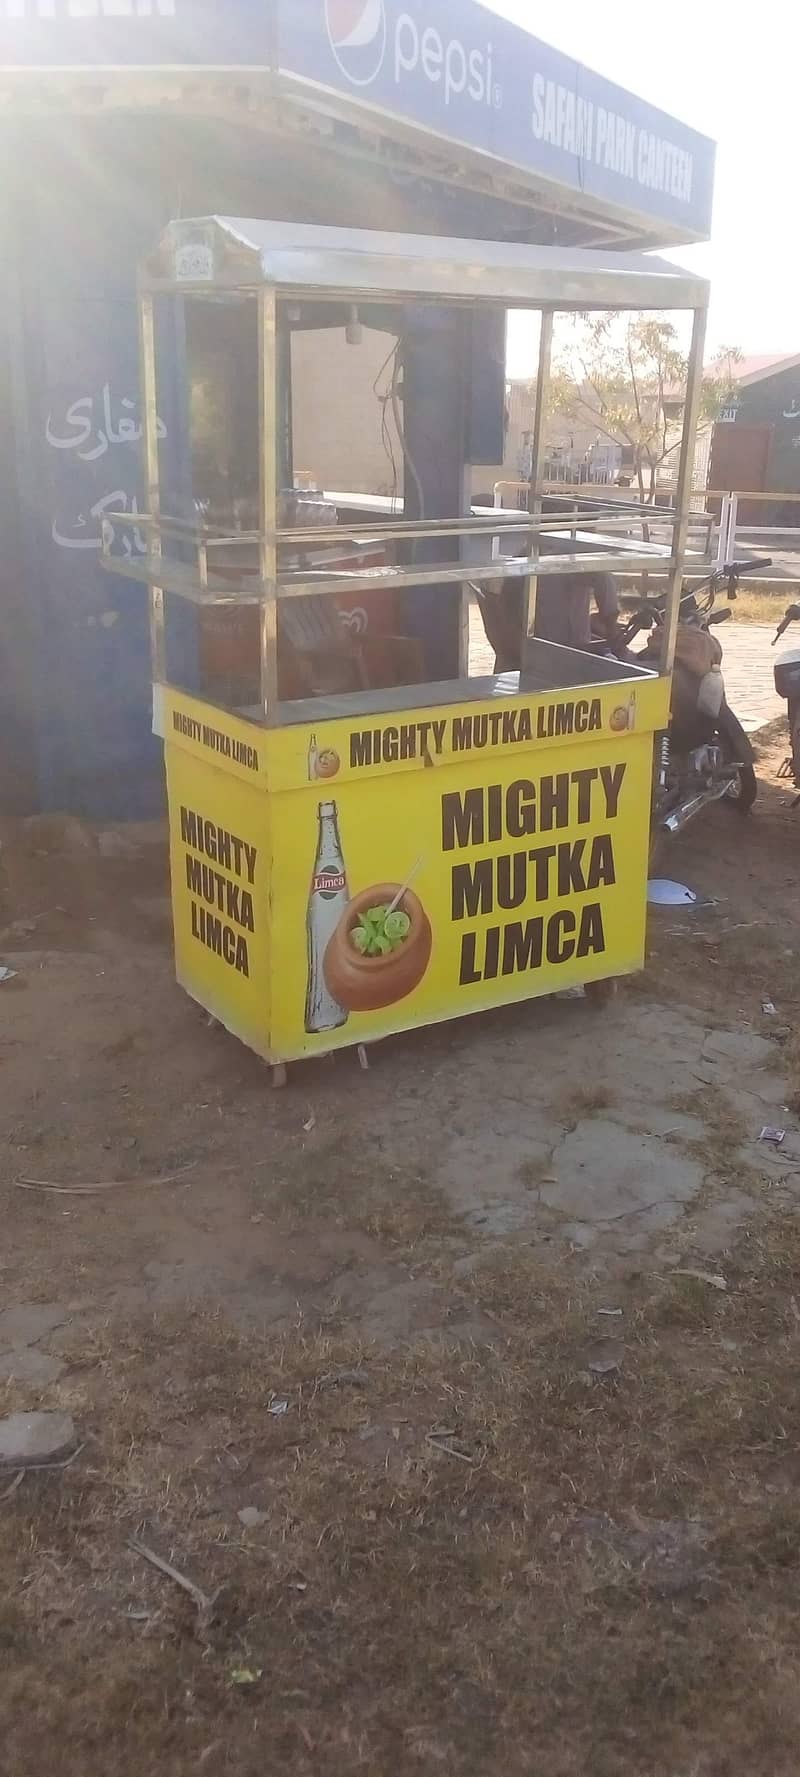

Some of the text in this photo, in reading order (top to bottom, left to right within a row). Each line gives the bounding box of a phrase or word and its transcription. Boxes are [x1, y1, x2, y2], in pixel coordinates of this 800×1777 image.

[394, 13, 492, 105] pepsi
[532, 72, 693, 203] SAFARI PARK CANTEEN
[173, 710, 259, 772] MIGHTY MUTKA LIMCA
[350, 698, 602, 768] MIGHTY MUTKA LIMCA
[180, 806, 258, 885] MIGHTY
[441, 762, 627, 852] MIGHTY
[185, 852, 255, 933] MUTKA
[313, 876, 345, 890] Limca
[451, 833, 616, 921] MUTKA
[191, 900, 250, 978] LIMCA
[459, 902, 606, 985] LIMCA
